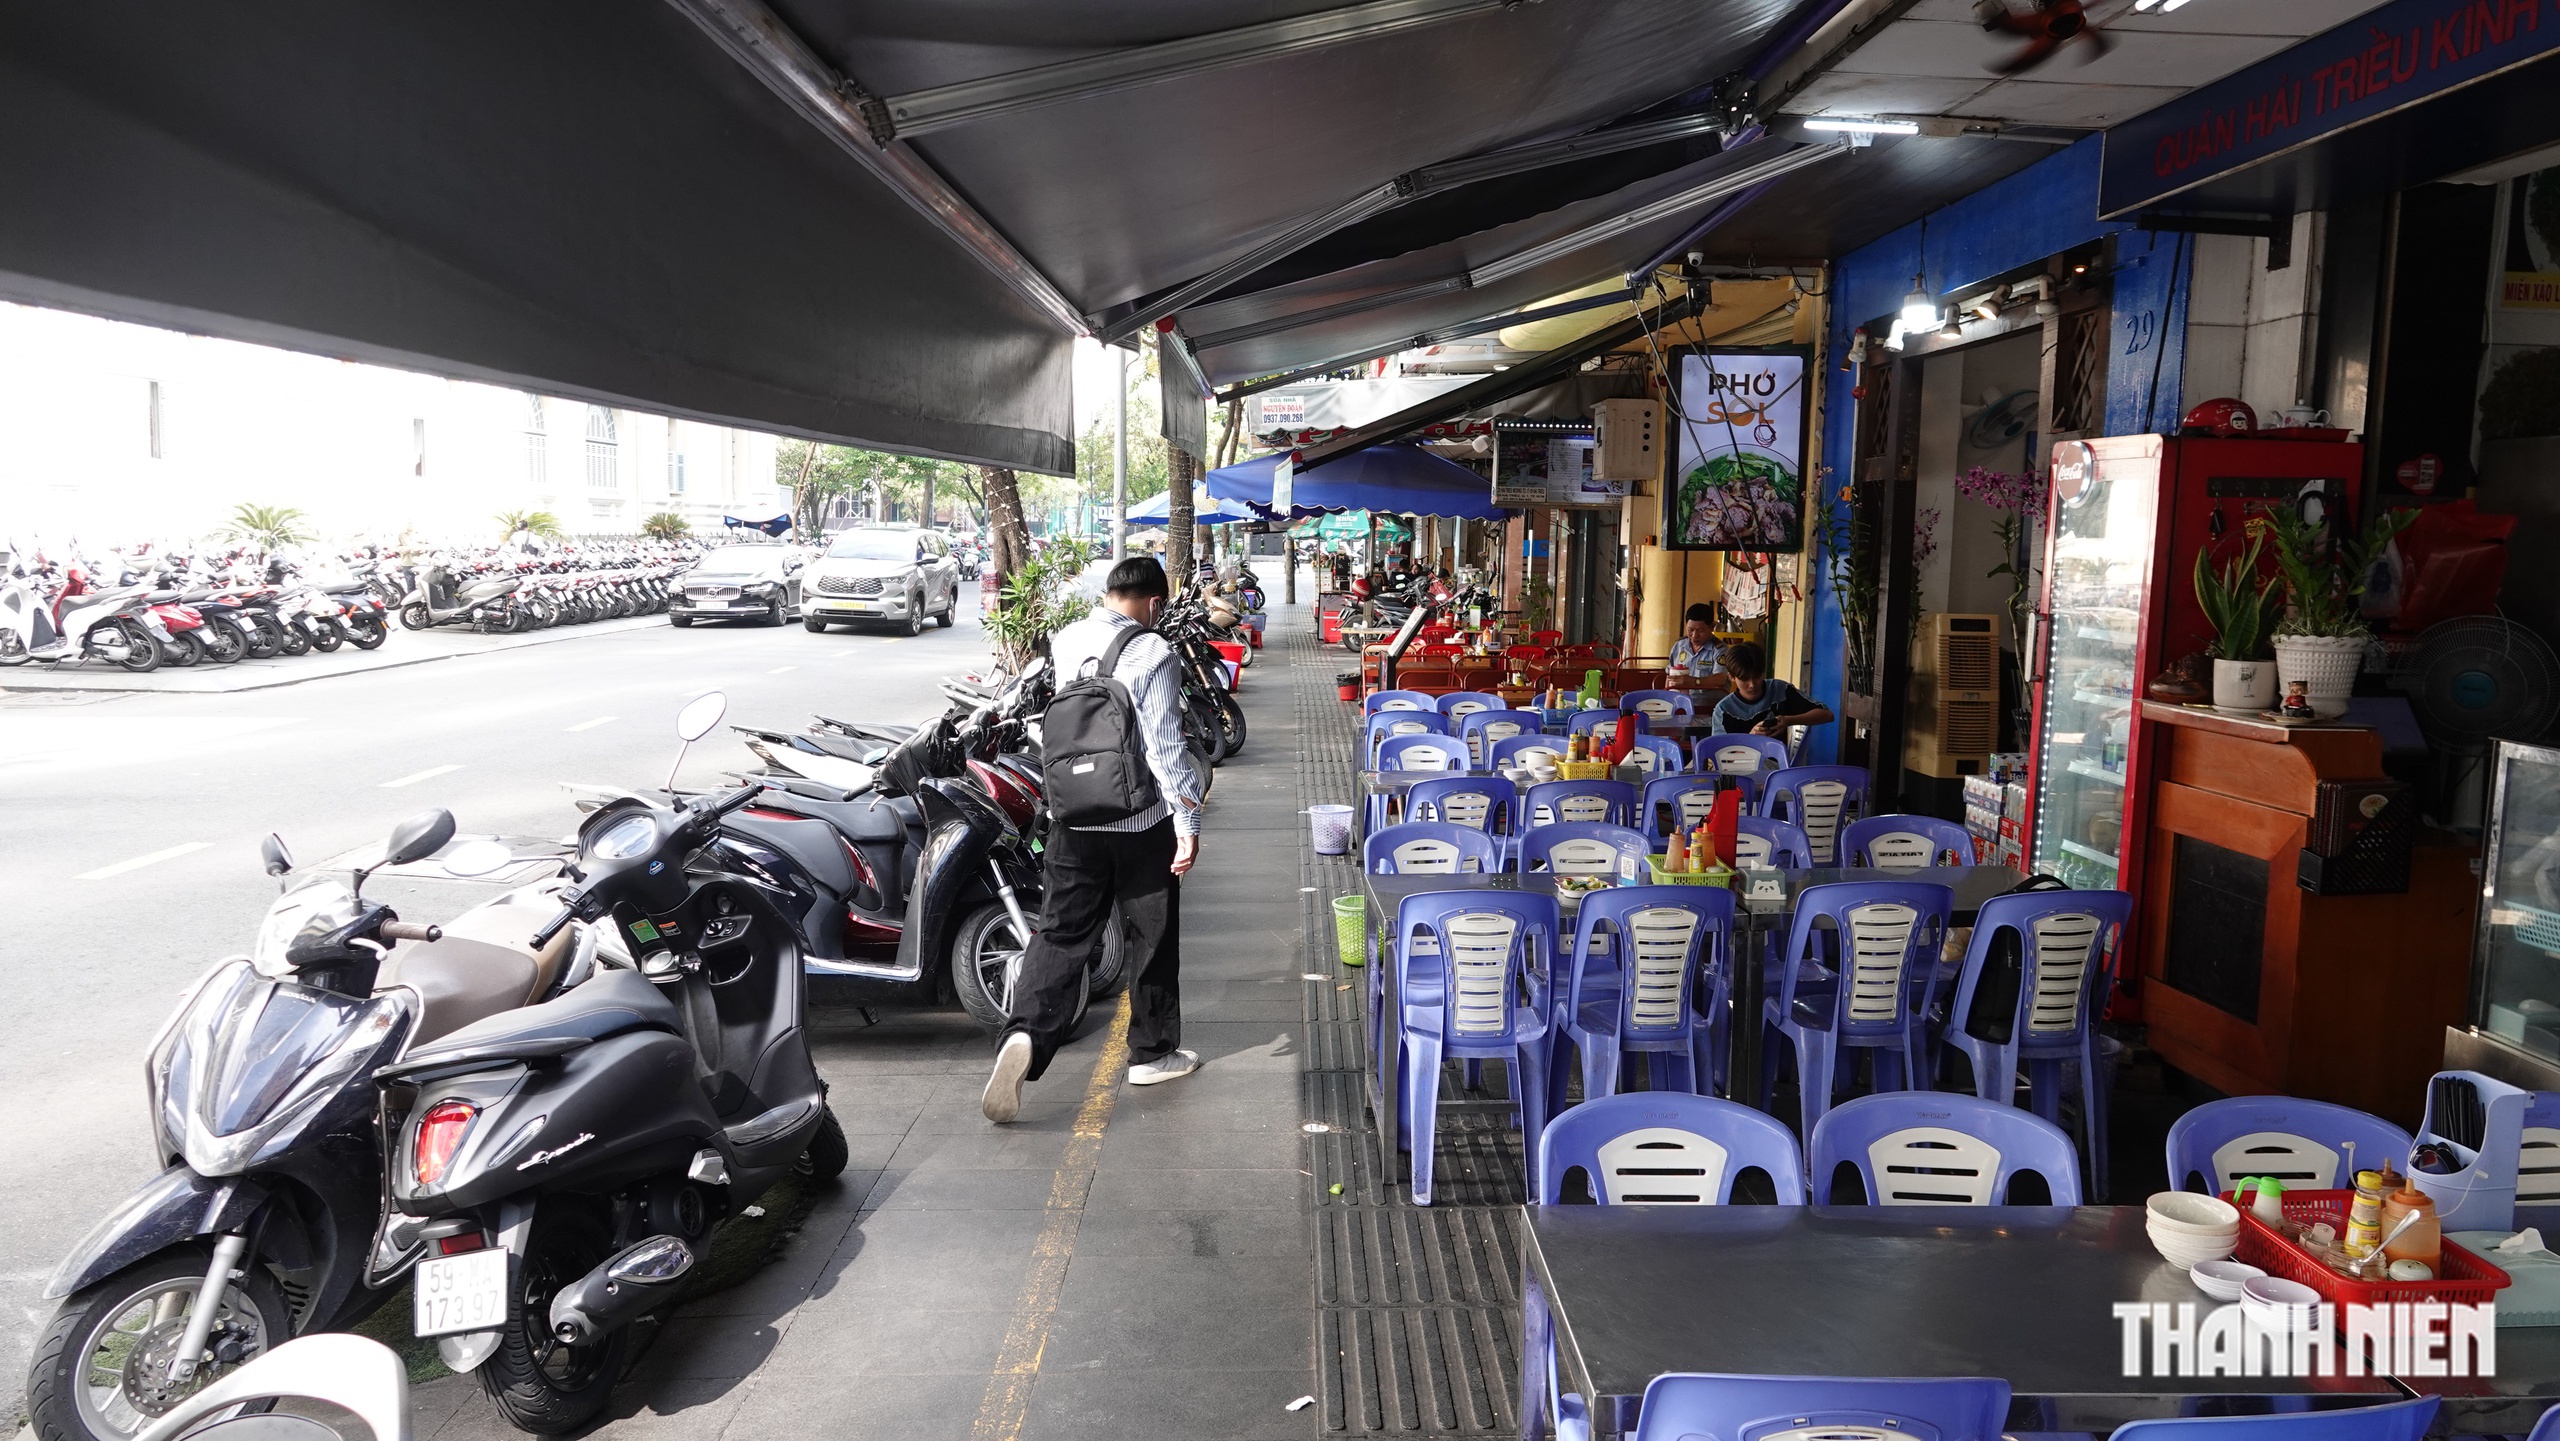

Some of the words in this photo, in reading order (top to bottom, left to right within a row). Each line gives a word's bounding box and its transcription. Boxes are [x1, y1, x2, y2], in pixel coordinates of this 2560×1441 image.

[2154, 107, 2237, 177] QUÁN
[2244, 72, 2303, 144] HẢI
[2311, 27, 2422, 117] TRIỀU
[2533, 280, 2552, 302] XÀO
[2124, 310, 2155, 356] 29
[1708, 366, 1777, 397] PHỞ
[1706, 397, 1775, 427] SOL
[425, 1289, 499, 1330] 173.97
